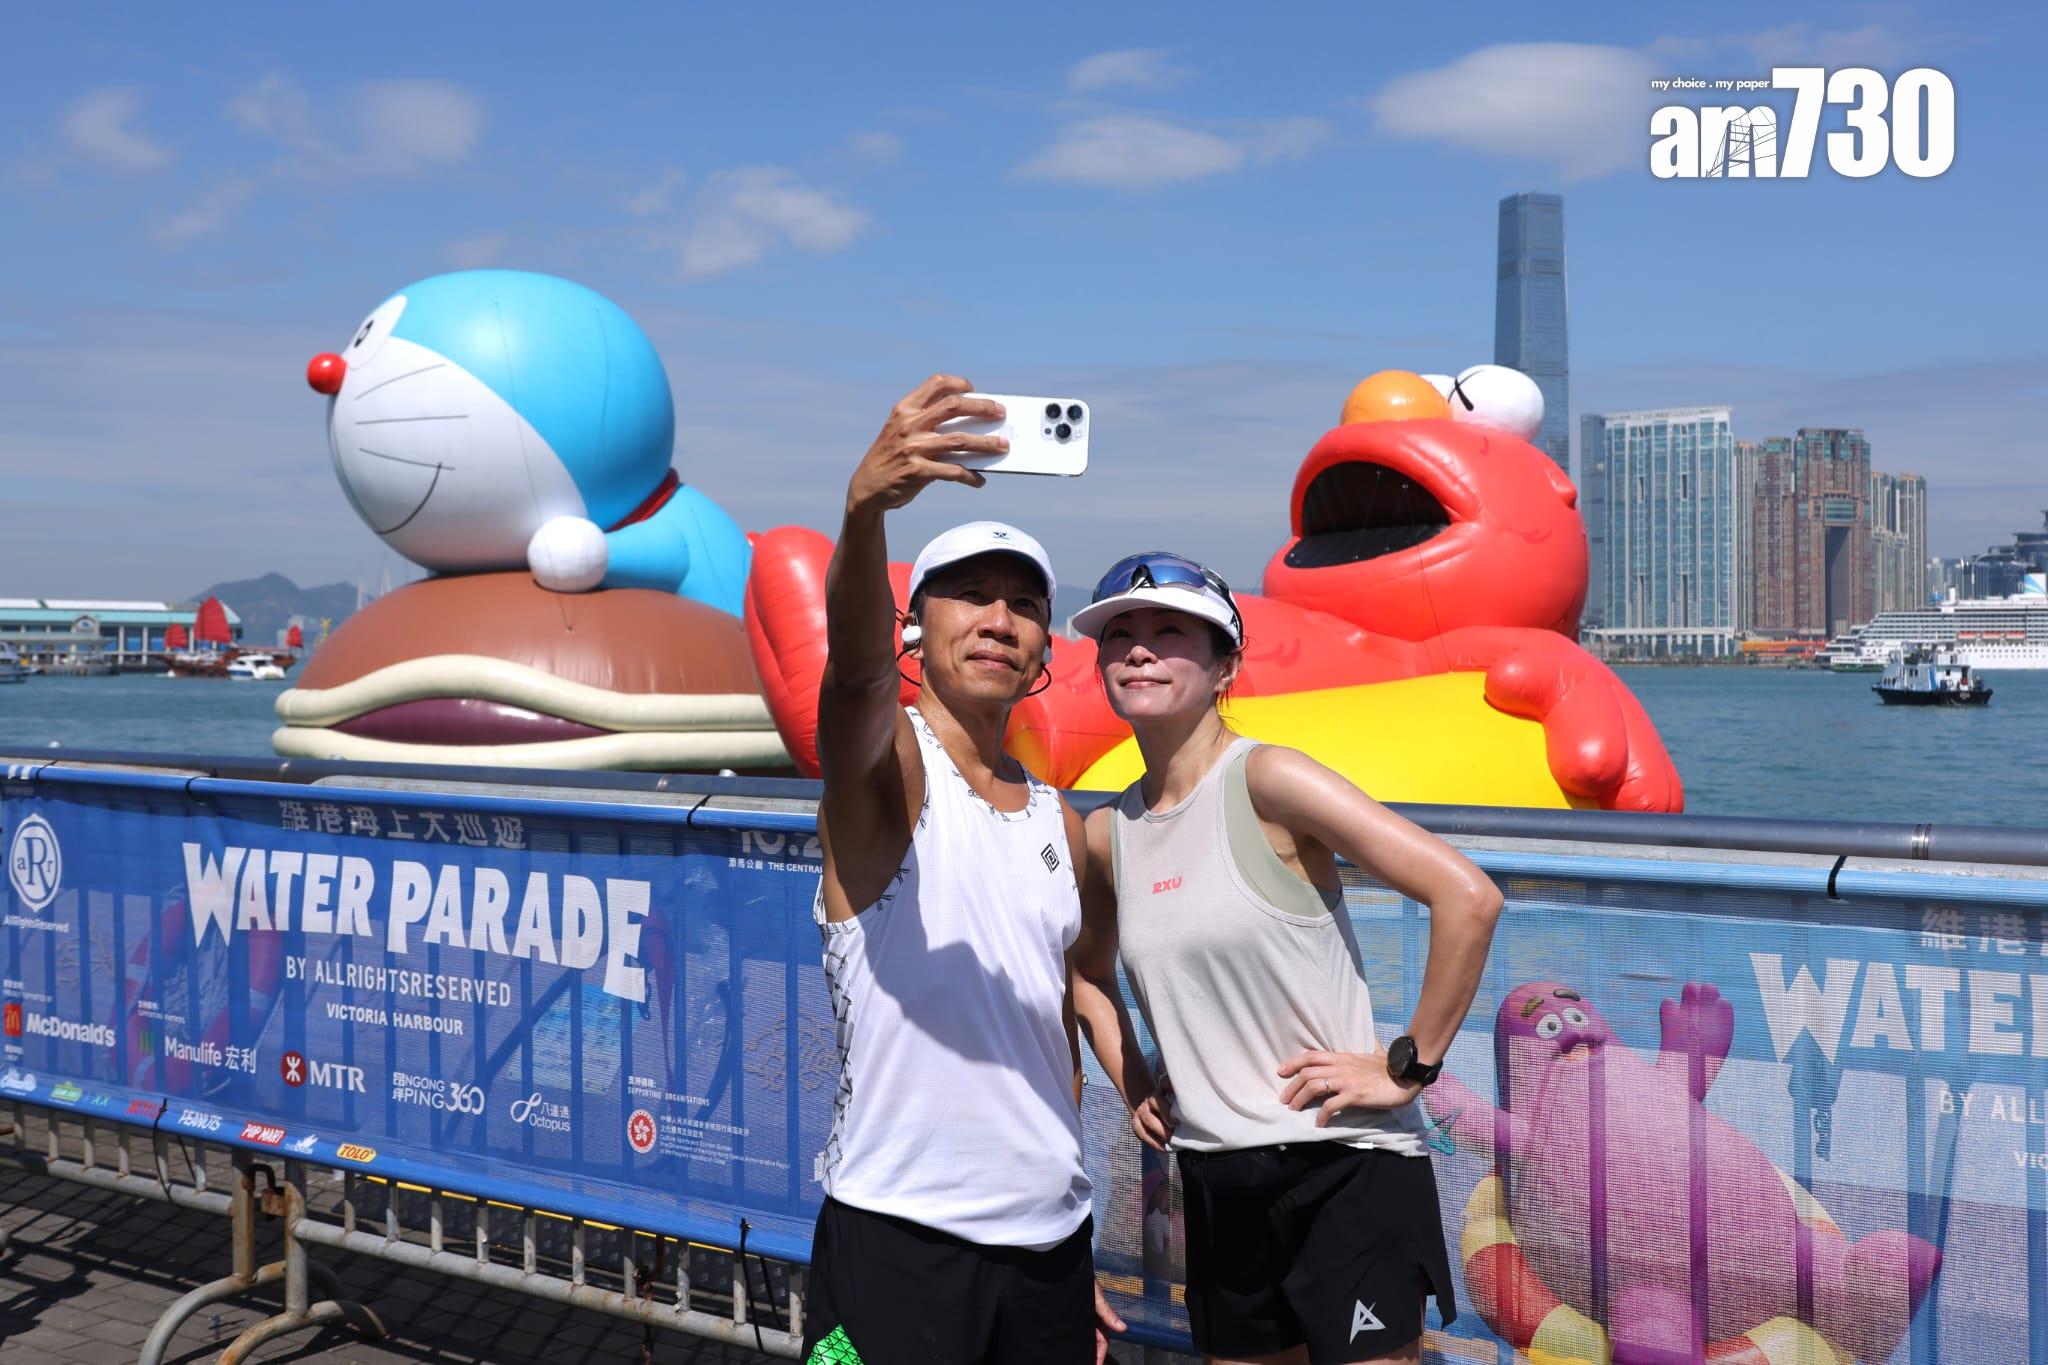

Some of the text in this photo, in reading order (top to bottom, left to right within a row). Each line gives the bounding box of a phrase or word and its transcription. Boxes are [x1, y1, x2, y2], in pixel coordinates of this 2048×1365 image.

[279, 800, 526, 850] 維港海上大巡遊
[768, 861, 785, 872] THE
[1152, 876, 1183, 895] 2XU
[182, 842, 651, 1004] WATER PARADE
[1921, 906, 2048, 955] 維港
[287, 956, 510, 1007] BY ALLRIGHTSRESERVED
[26, 1012, 116, 1048] McDonald's
[326, 1002, 463, 1036] VICTORIA HARBOUR
[165, 1036, 257, 1074] Manulife 宏利
[310, 1060, 366, 1093] MTR
[446, 1083, 485, 1115] 360
[1940, 1089, 1974, 1119] BY
[178, 1110, 222, 1131] PEANUTS
[242, 1123, 261, 1139] POP
[529, 1113, 570, 1132] Octopus
